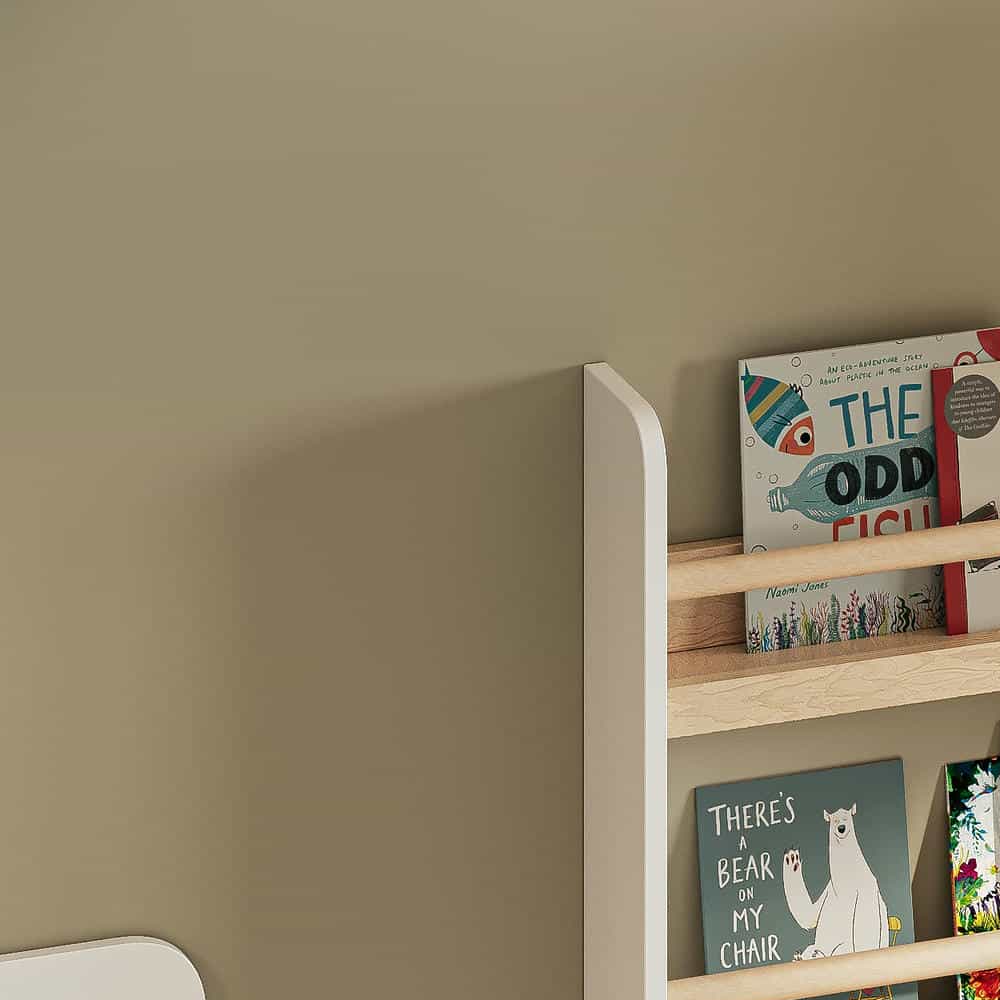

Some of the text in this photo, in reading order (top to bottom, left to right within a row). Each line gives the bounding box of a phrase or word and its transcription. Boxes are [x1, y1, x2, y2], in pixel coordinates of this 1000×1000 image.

[829, 382, 922, 448] THE
[825, 447, 935, 505] ODD
[765, 581, 830, 600] Naomi Jones
[707, 791, 797, 836] THERE'S
[738, 835, 748, 851] A
[717, 851, 776, 889] BEAR
[738, 886, 755, 903] ON
[732, 904, 764, 933] MY
[719, 934, 782, 969] CHAIR
